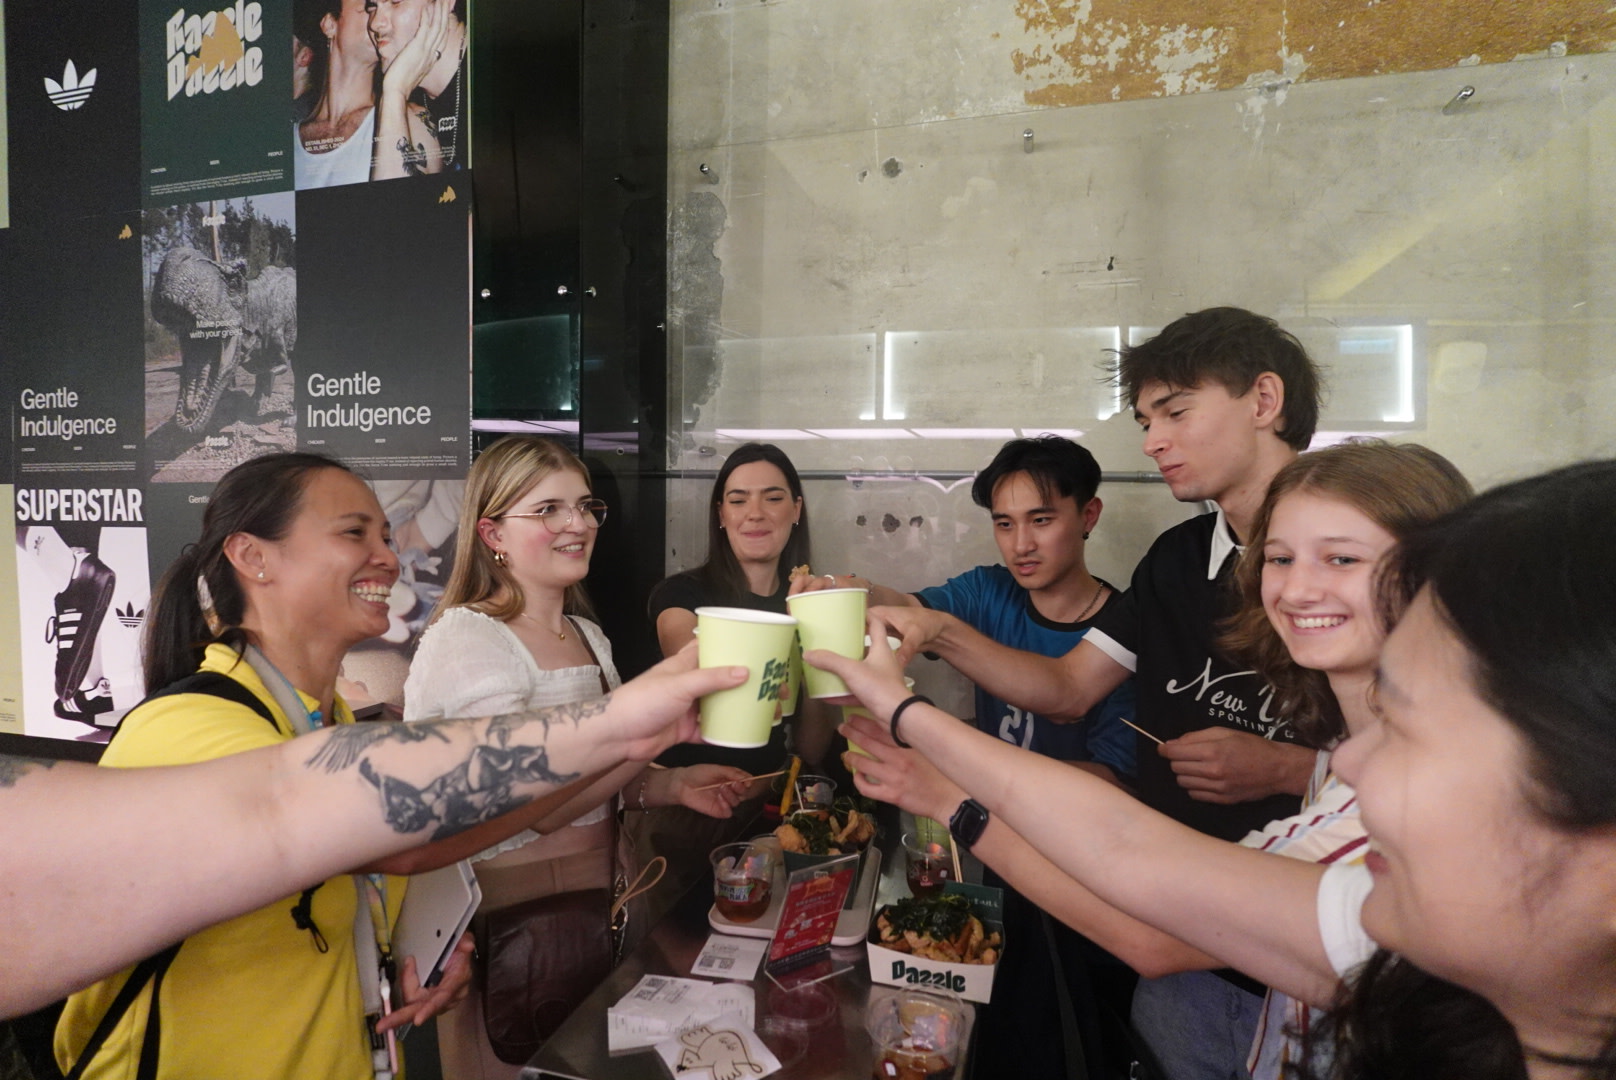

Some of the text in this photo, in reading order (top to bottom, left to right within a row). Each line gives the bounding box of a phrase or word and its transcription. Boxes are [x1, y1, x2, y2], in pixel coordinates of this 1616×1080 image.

[189, 330, 205, 339] with
[205, 330, 221, 340] your
[20, 386, 79, 410] Gentle
[307, 370, 382, 398] Gentle
[20, 414, 117, 441] Indulgence
[307, 402, 432, 433] Indulgence
[16, 488, 144, 522] SUPERSTAR
[1166, 656, 1259, 713] New
[891, 959, 966, 993] Dazzle
